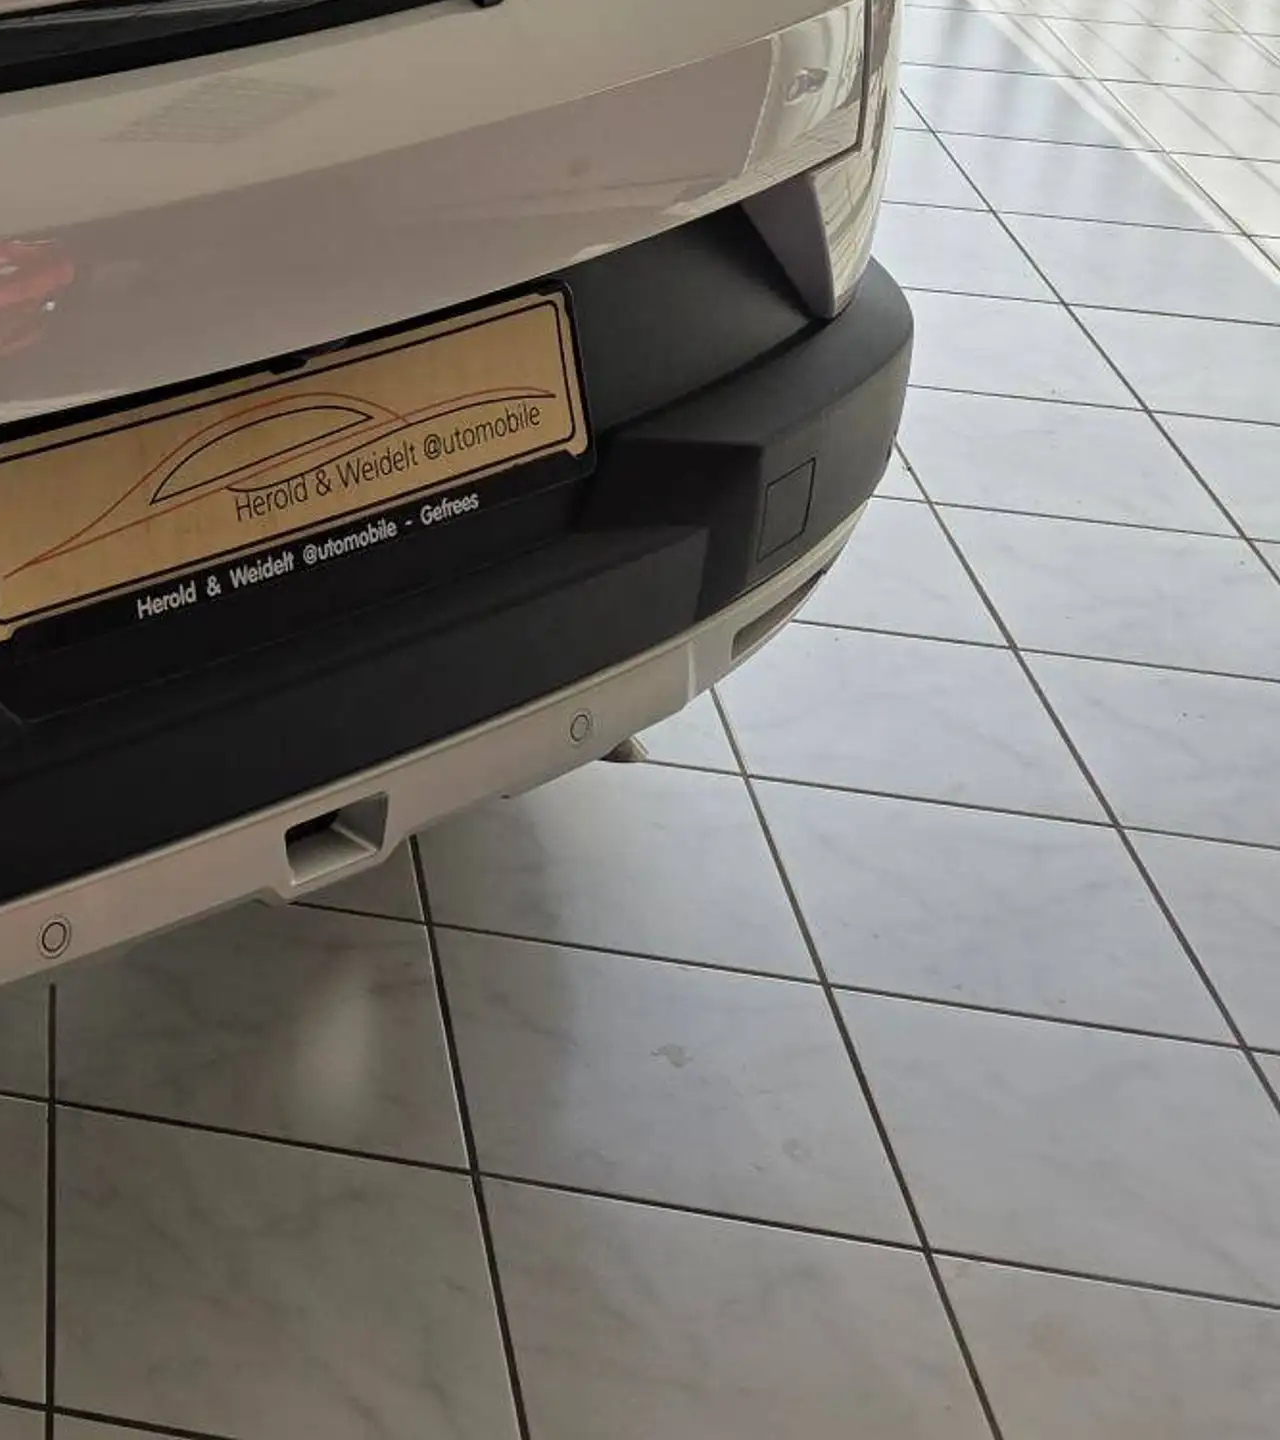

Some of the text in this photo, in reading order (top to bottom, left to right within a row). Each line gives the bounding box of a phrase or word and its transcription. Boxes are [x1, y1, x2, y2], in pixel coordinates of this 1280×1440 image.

[236, 404, 541, 522] Herold & Weidelt @utomobile
[137, 580, 197, 620] Herold
[206, 575, 222, 597] &
[230, 552, 294, 590] Weidelt
[303, 517, 398, 566] @utomobile
[420, 491, 481, 527] Gefrees
